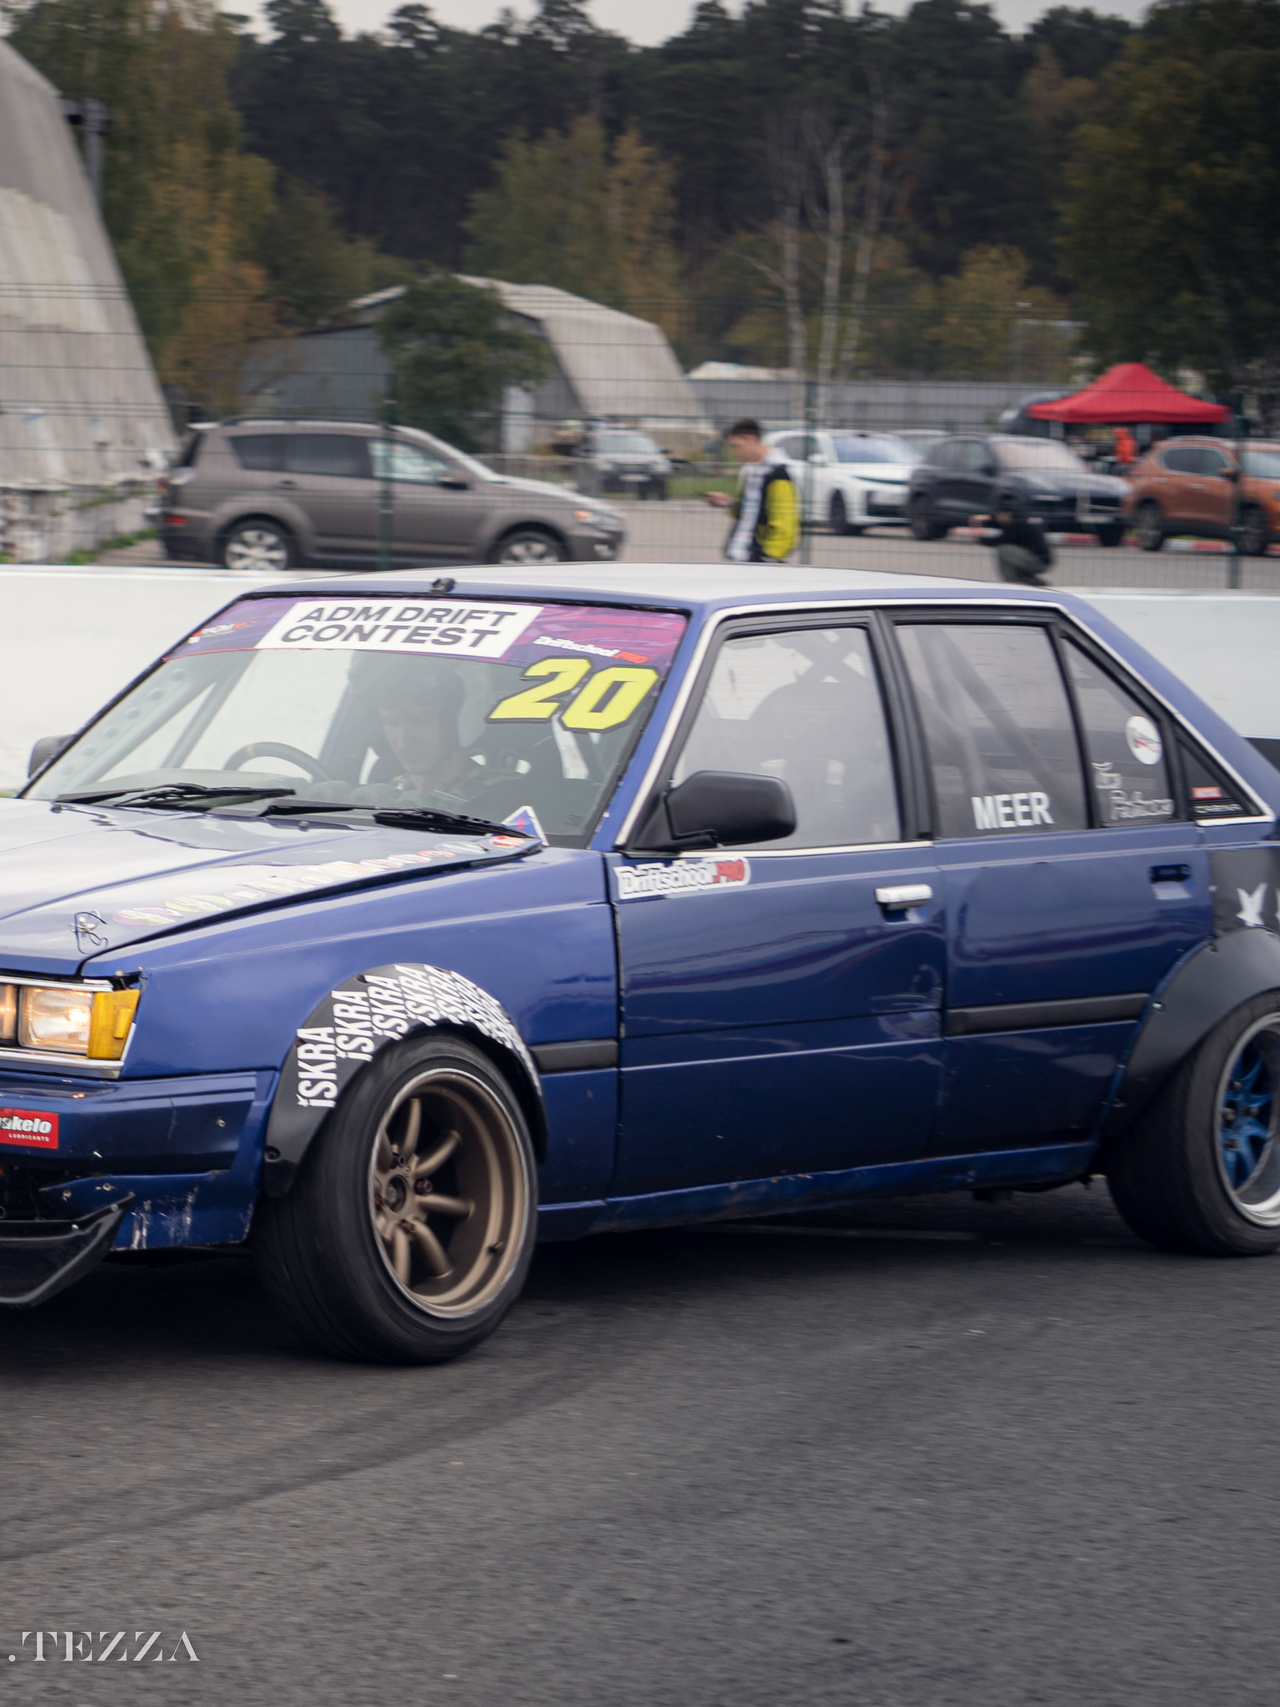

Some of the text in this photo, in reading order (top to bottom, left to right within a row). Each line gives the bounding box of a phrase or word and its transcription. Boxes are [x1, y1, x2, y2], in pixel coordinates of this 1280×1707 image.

[297, 606, 518, 627] ADM DRIFT
[281, 624, 501, 648] CONTEST
[486, 656, 660, 733] 20
[972, 791, 1054, 830] MEER
